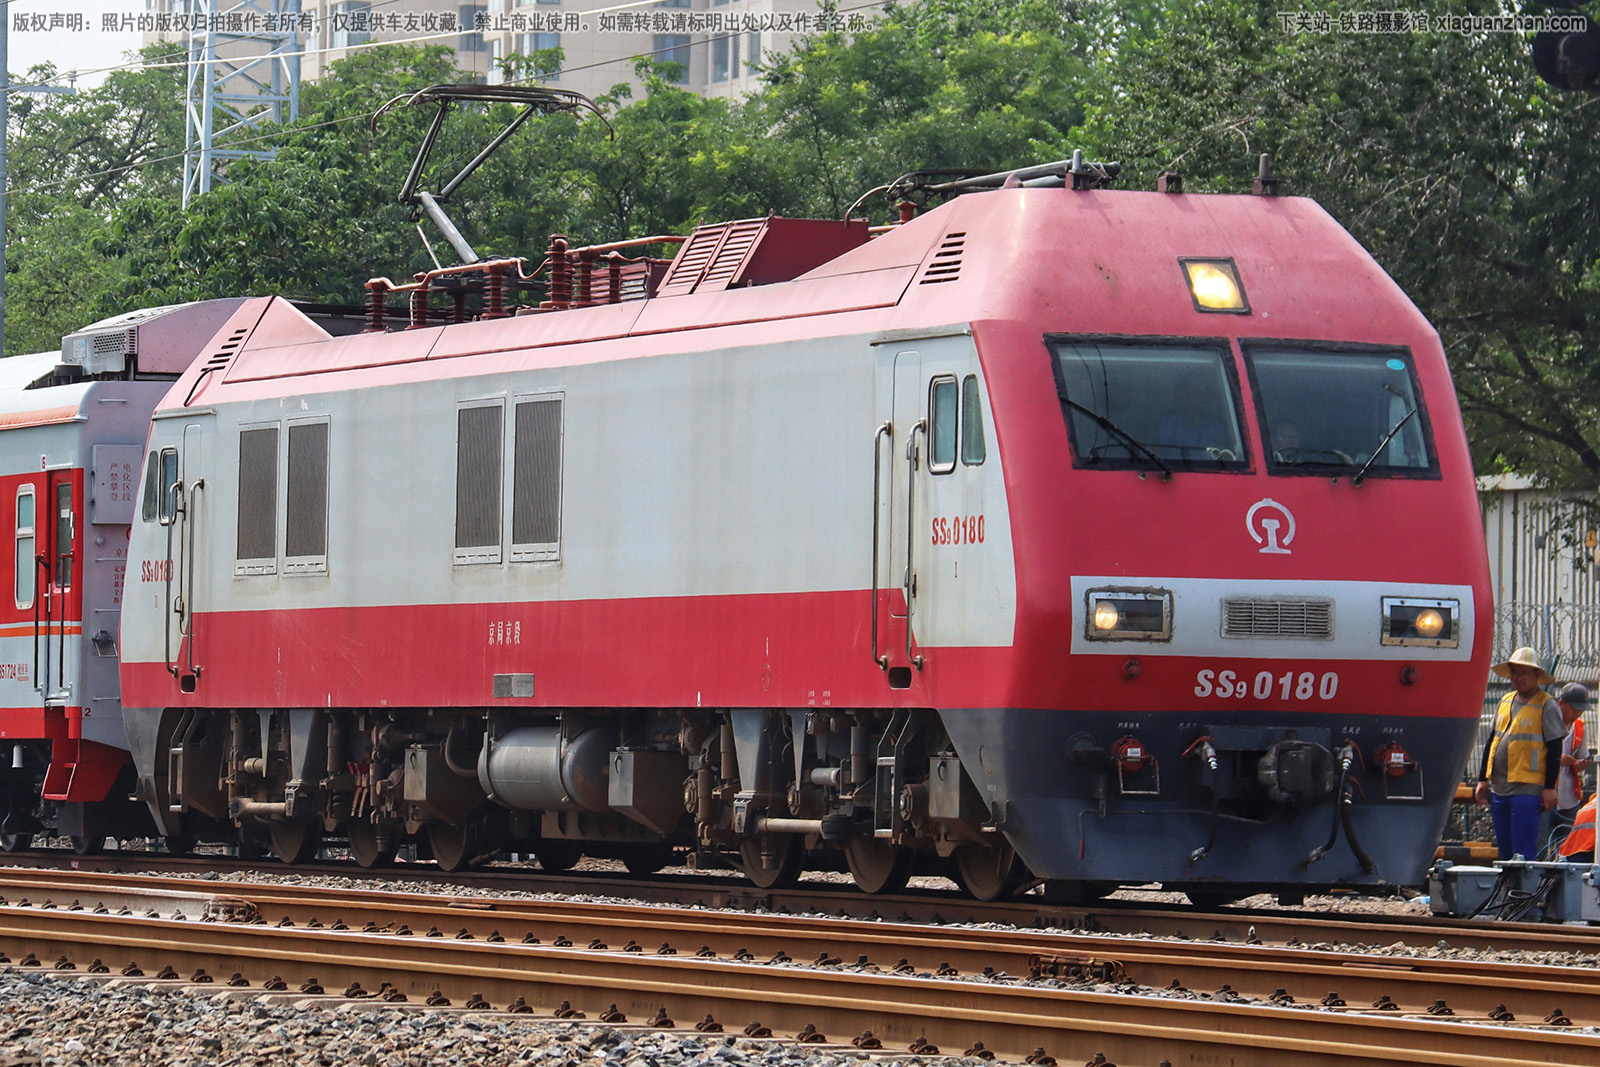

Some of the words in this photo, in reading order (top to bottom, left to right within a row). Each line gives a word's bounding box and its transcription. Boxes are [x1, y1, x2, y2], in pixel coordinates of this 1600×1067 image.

[932, 514, 985, 546] SS90180
[1194, 669, 1339, 700] SS90180
[84, 707, 91, 717] 2
